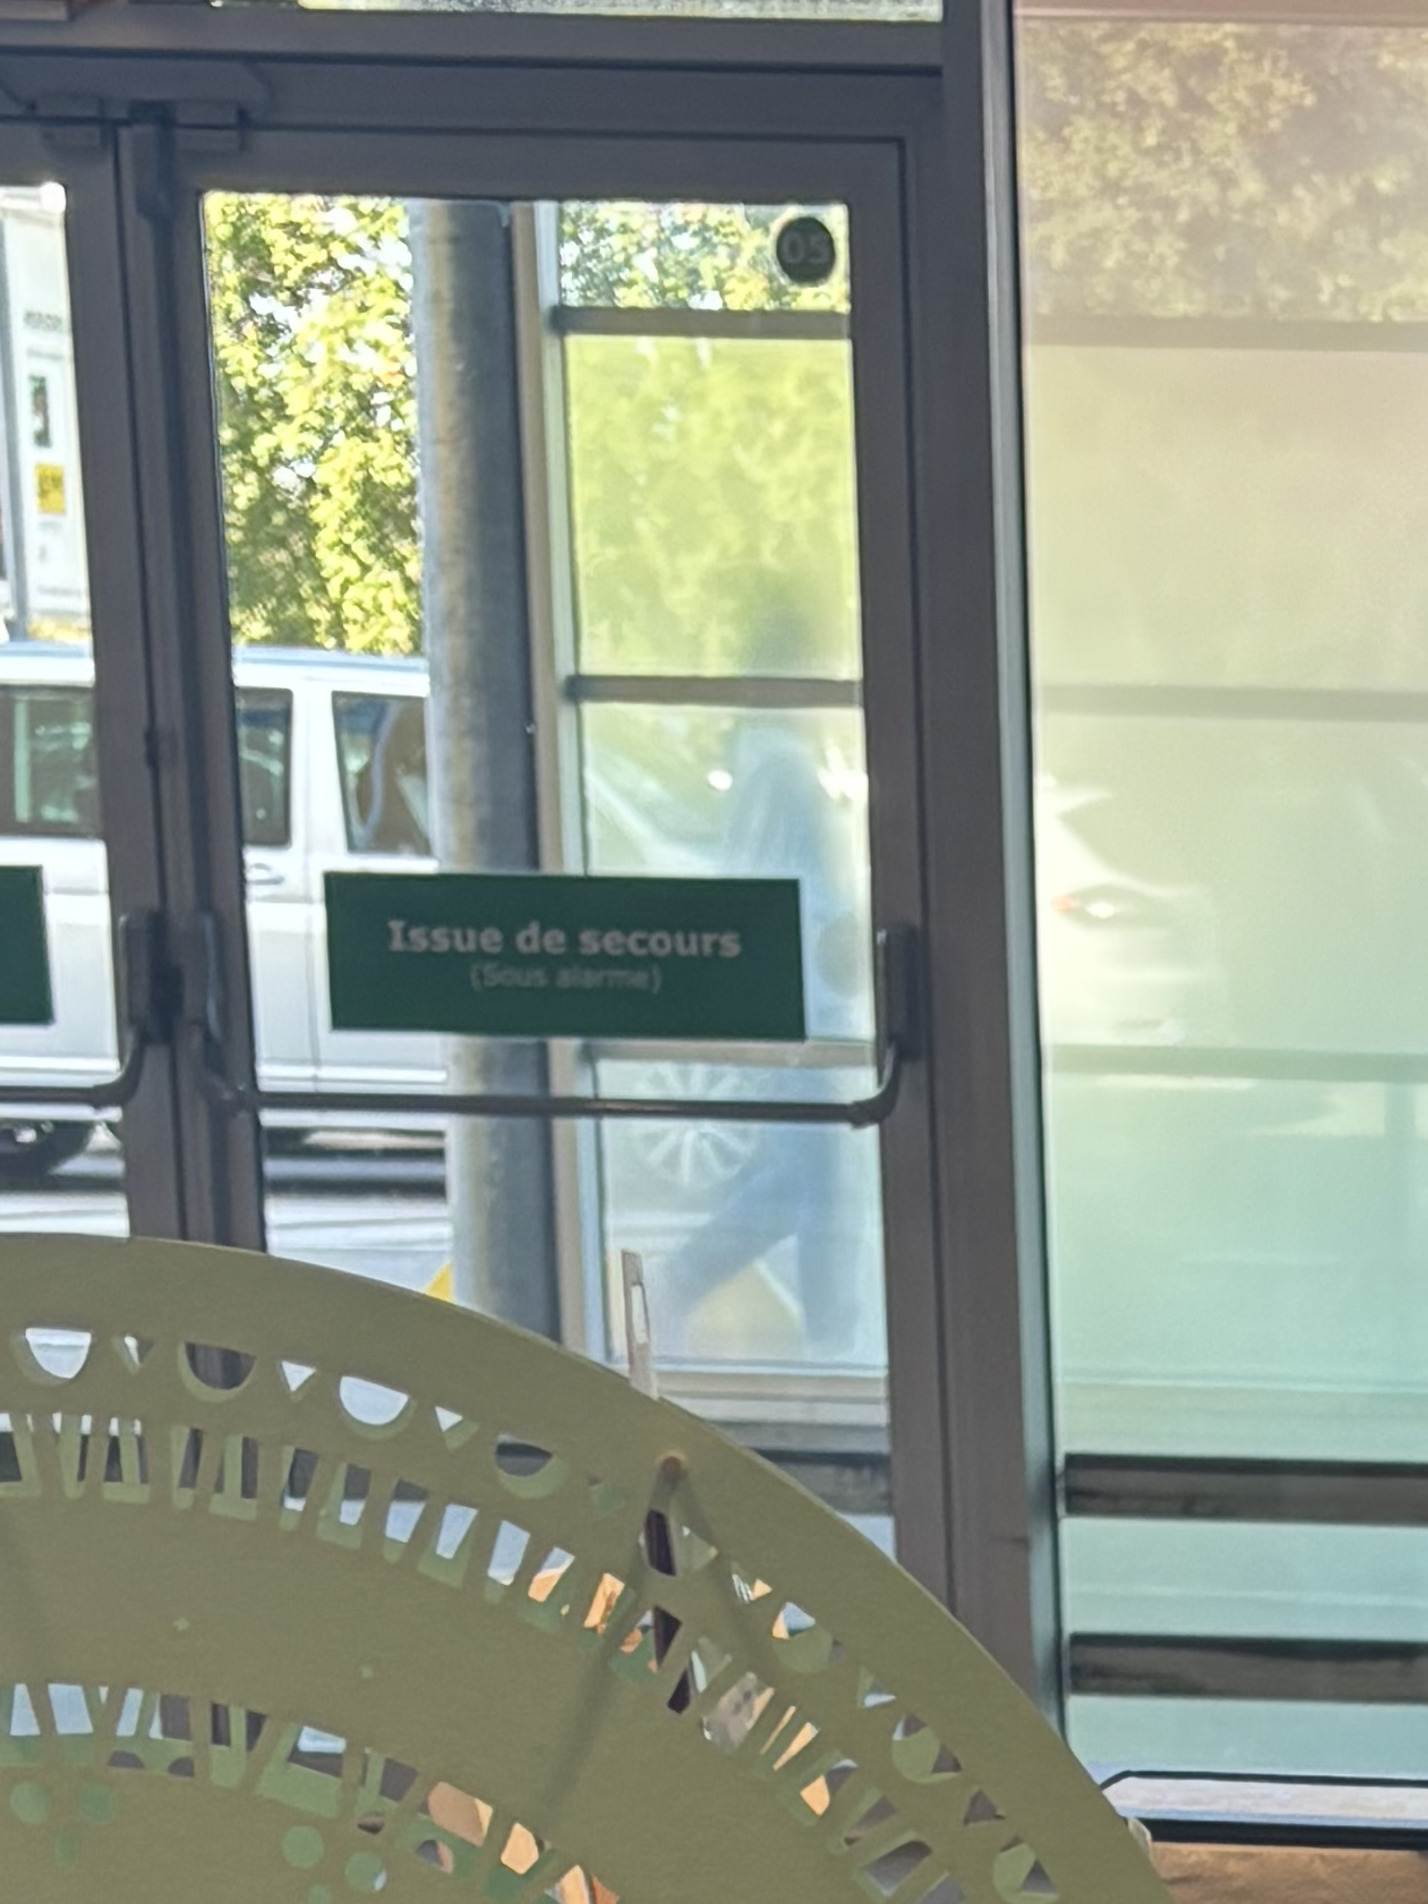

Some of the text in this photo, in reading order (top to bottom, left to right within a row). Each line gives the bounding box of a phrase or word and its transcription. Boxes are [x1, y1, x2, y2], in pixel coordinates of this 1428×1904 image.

[388, 919, 742, 958] Issue de secours
[469, 963, 662, 994] (Sous alarme)
